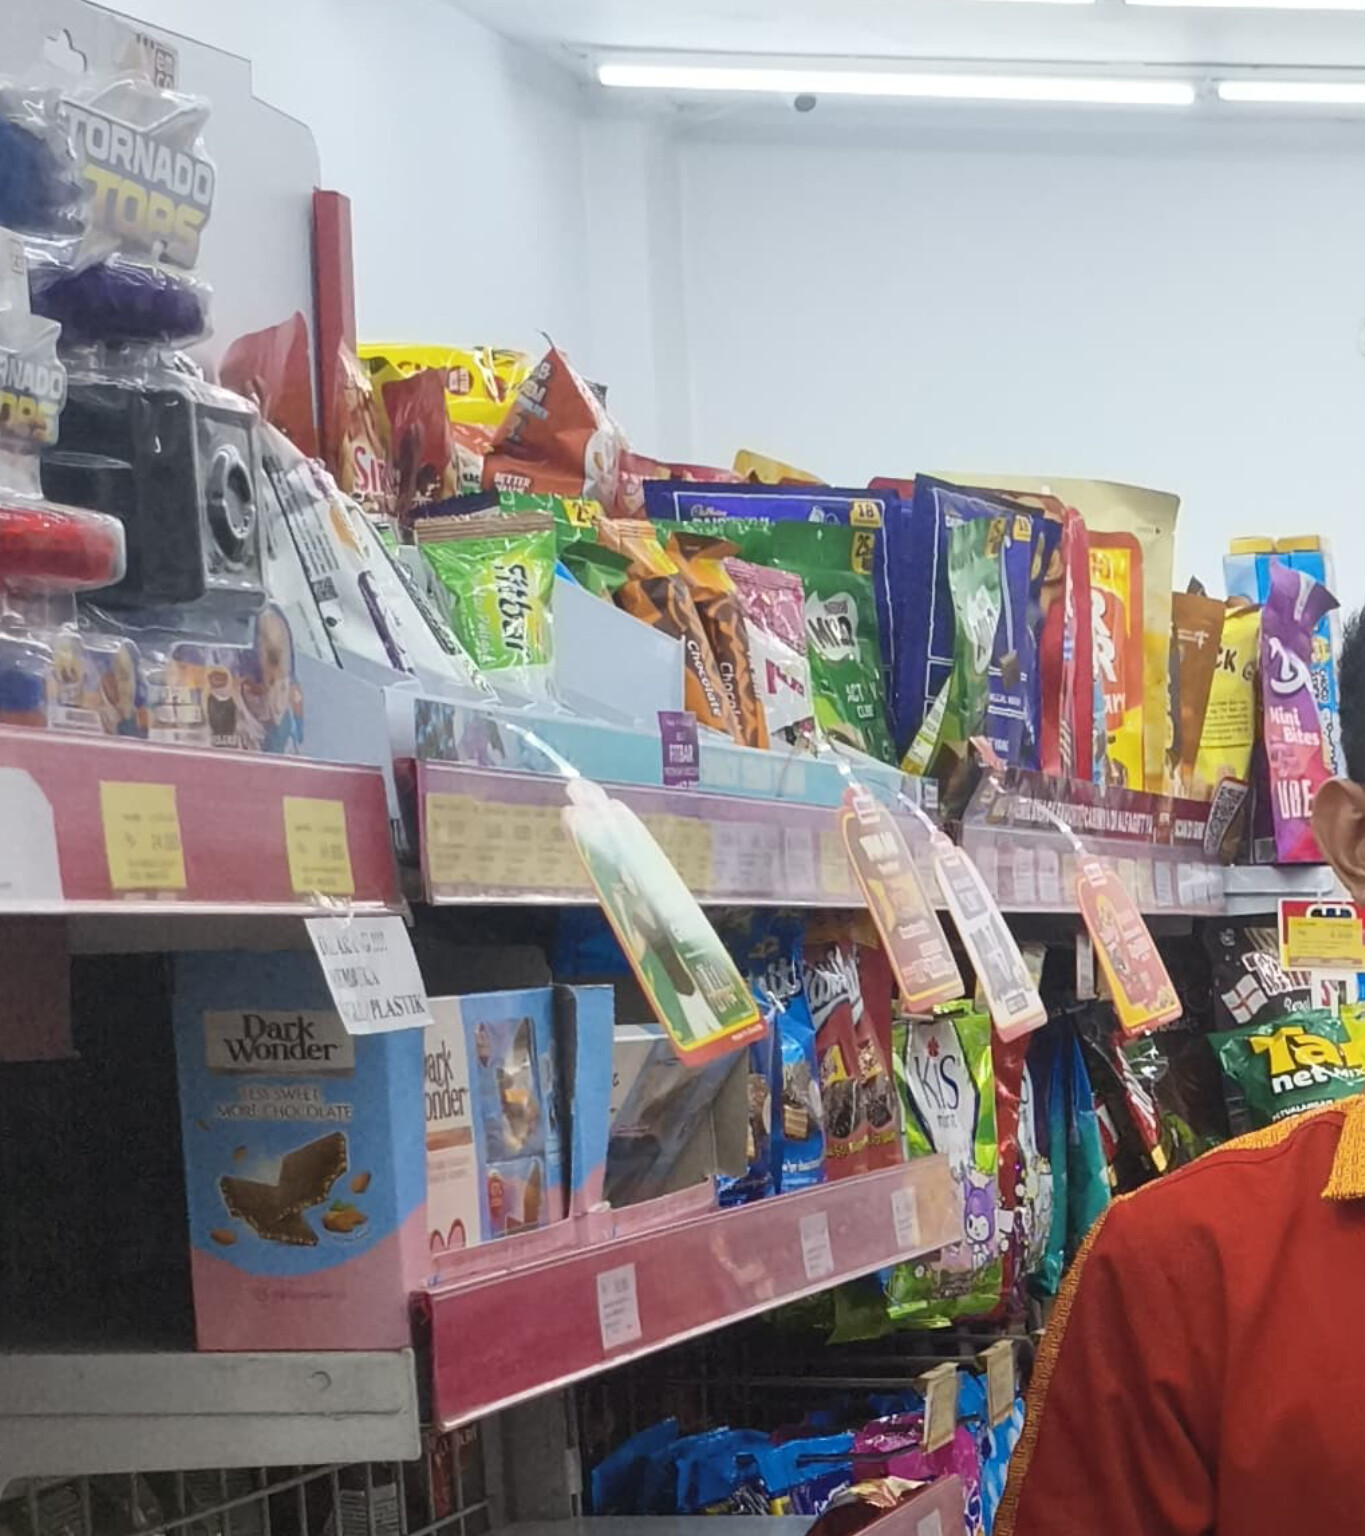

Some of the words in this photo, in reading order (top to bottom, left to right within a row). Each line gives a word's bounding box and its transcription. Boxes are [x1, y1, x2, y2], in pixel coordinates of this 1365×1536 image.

[64, 101, 215, 207] TORNADO
[83, 163, 208, 268] TOPS
[686, 638, 723, 718] Chocolate
[1283, 727, 1321, 746] Bites
[242, 1013, 315, 1040] Dark
[223, 1037, 340, 1063] Wonder
[425, 1040, 455, 1085] ark
[913, 1054, 960, 1111] KIS
[1272, 1064, 1334, 1094] net
[425, 1087, 469, 1122] onder
